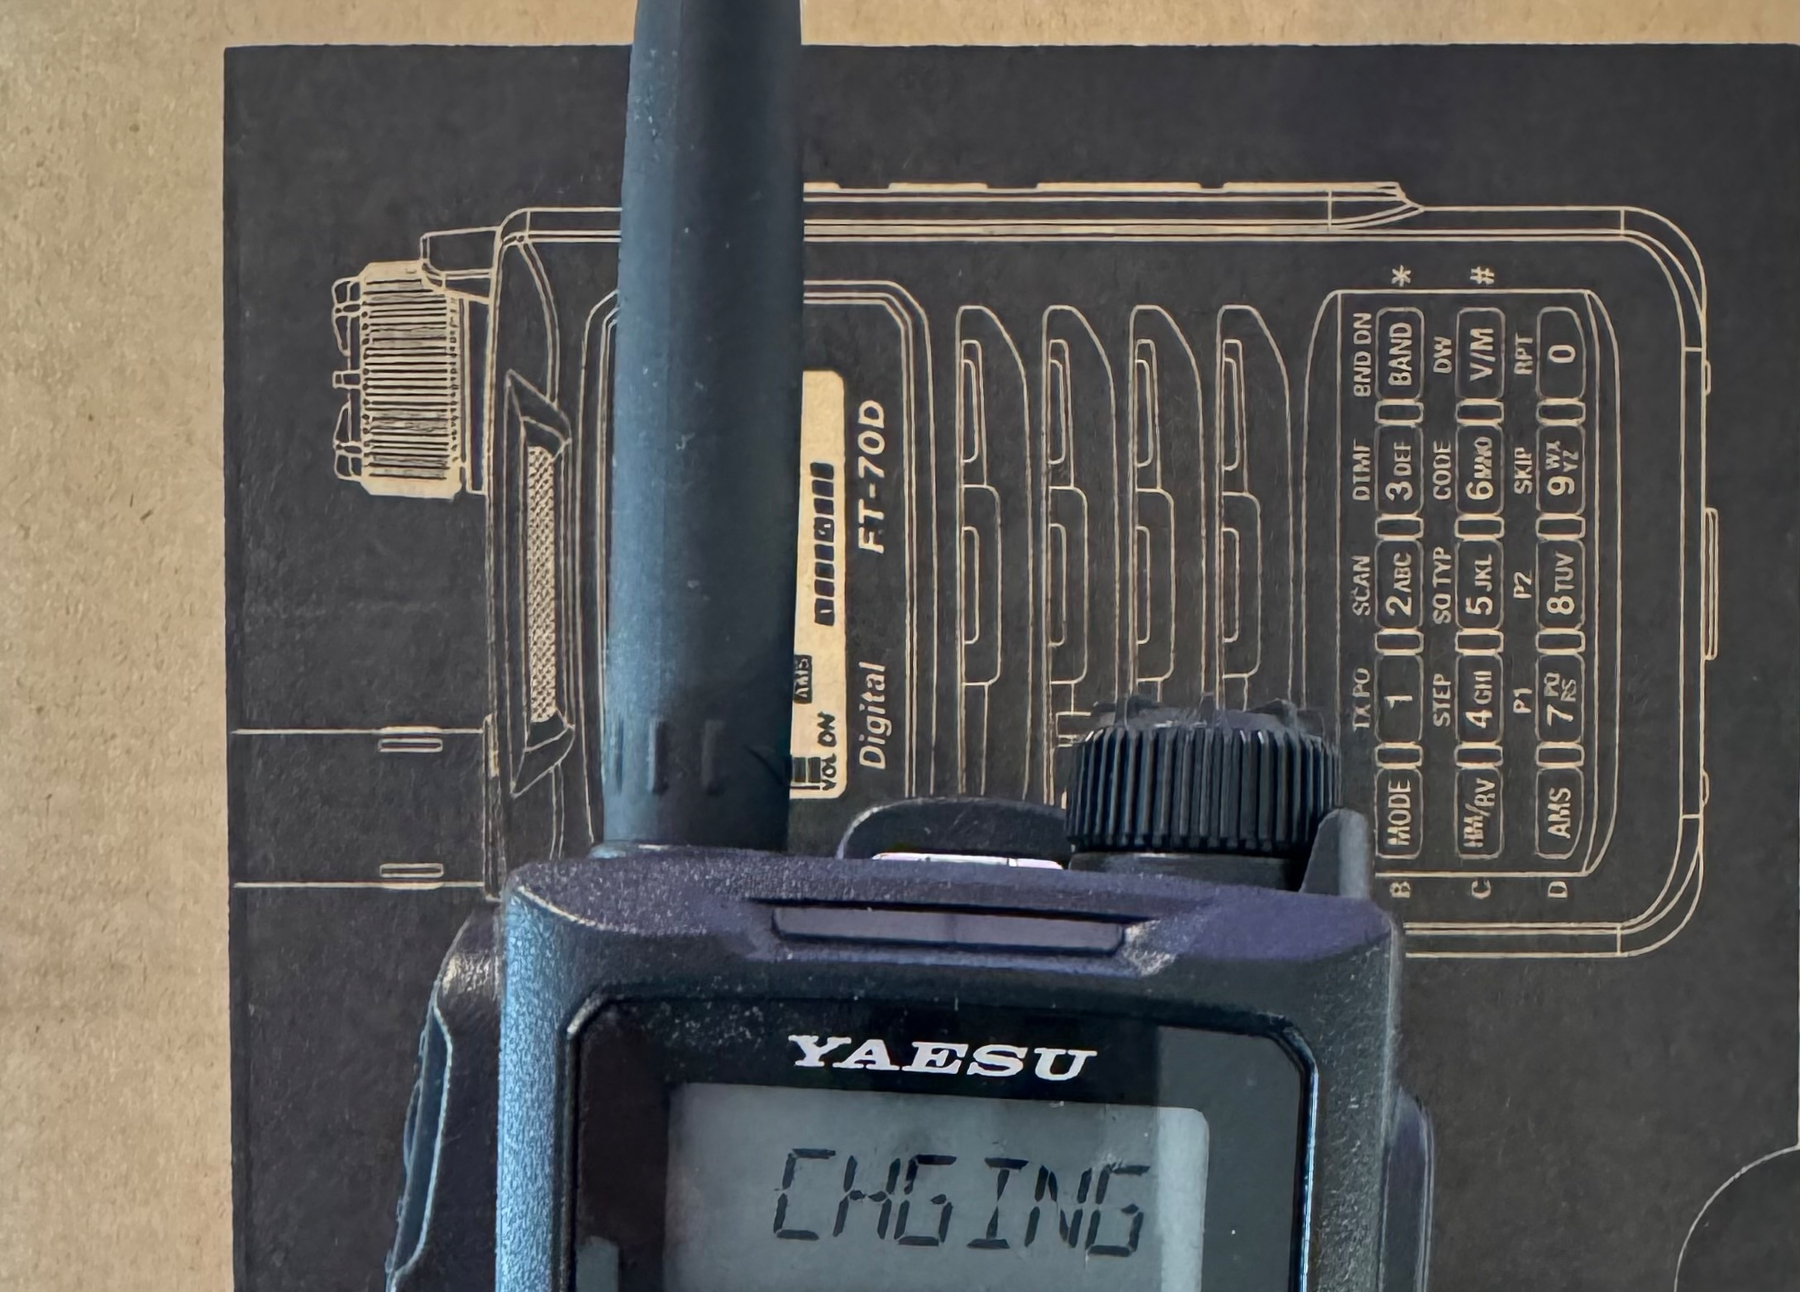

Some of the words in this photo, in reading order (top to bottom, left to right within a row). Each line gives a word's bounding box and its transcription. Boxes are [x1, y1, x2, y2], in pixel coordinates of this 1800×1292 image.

[1353, 313, 1372, 344] DN
[1353, 353, 1371, 396] BND
[1389, 323, 1412, 385] BAND
[1433, 336, 1451, 373] DW
[1470, 328, 1495, 381] V/M
[1514, 332, 1534, 375] RPT
[857, 400, 884, 554] FT-70D
[1433, 441, 1451, 500] CODE
[1514, 447, 1532, 494] SKIP
[1352, 555, 1371, 615] SCAN
[1433, 547, 1451, 588] TYP
[1514, 571, 1532, 599] P2
[1352, 668, 1371, 697] PO
[1433, 674, 1451, 727] STEP
[1514, 688, 1532, 713] P1
[859, 662, 892, 769] Digital
[1388, 779, 1411, 846] MODE
[1548, 787, 1571, 839] AMS
[788, 1035, 1096, 1081] YAESU
[772, 1148, 1151, 1258] CHGING
